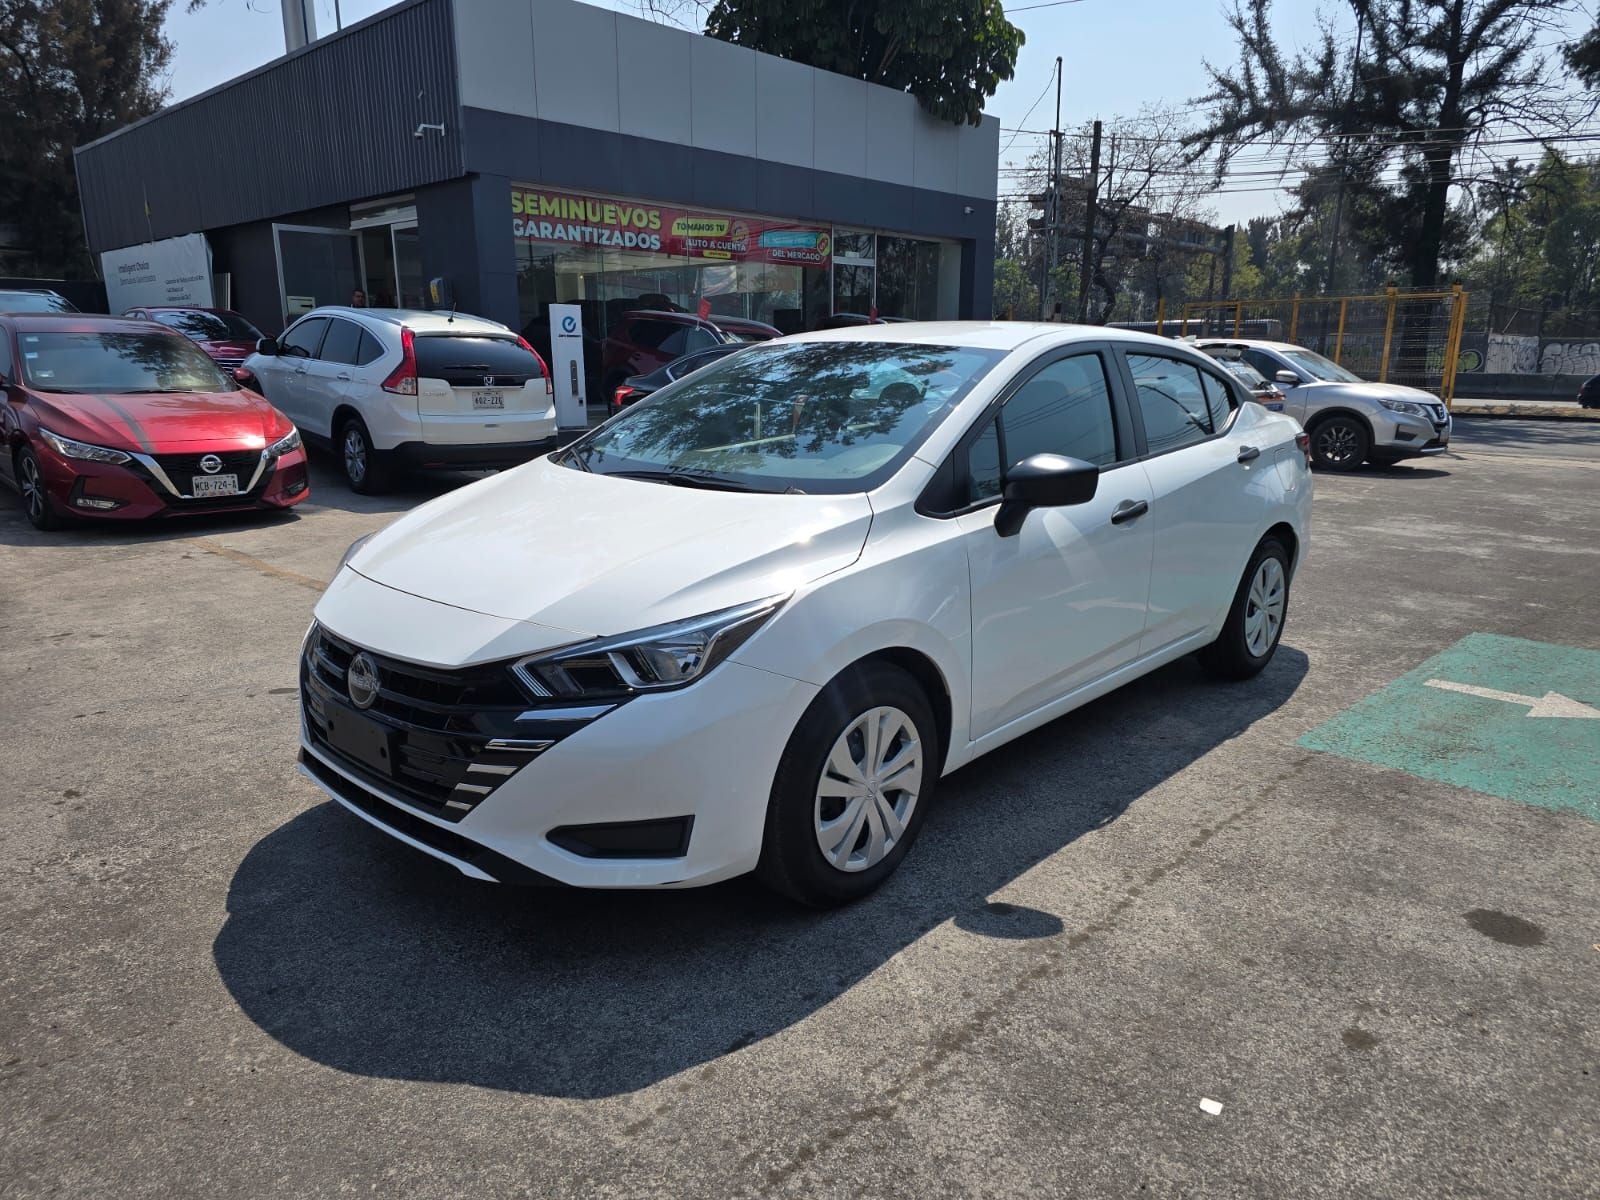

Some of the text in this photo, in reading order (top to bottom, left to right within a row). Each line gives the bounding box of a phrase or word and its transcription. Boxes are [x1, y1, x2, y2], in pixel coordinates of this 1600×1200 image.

[511, 191, 661, 230] SEMINUEVOS
[512, 218, 661, 250] GARANTIZADOS
[686, 238, 746, 251] AUTO A CUENTA
[772, 249, 821, 261] DEL MERCADO
